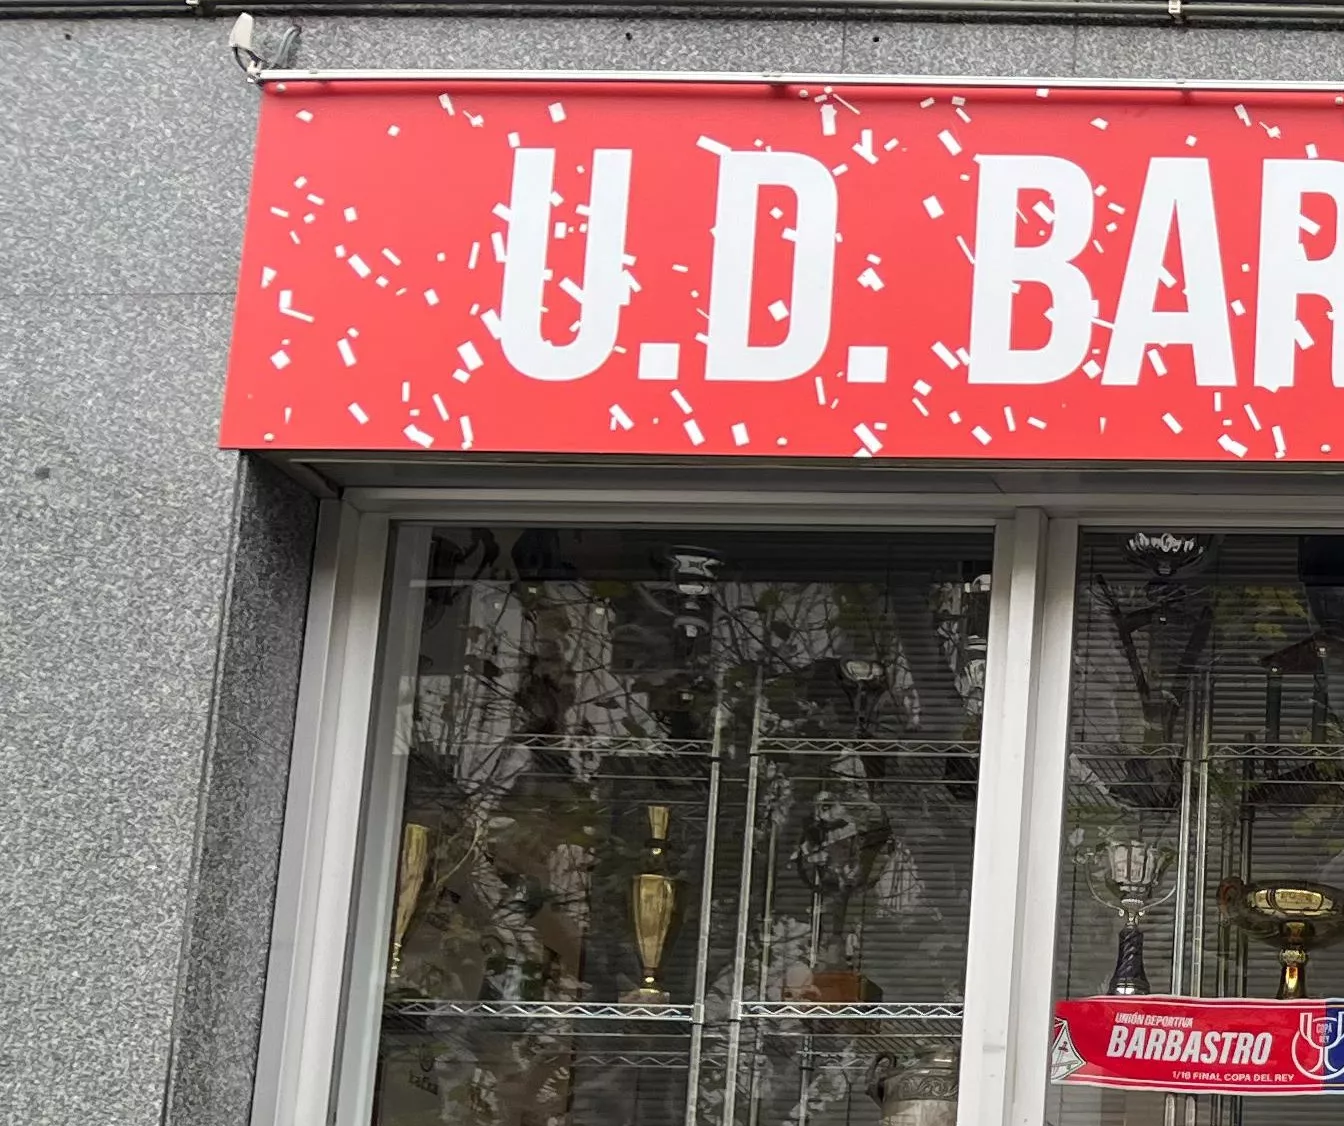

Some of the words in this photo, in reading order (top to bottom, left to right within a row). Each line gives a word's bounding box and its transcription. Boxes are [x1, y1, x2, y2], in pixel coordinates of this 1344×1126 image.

[498, 147, 888, 382] U.D.
[1146, 1013, 1194, 1029] DEPORTIVA
[1106, 1024, 1273, 1066] BARBASTRO
[1193, 1071, 1221, 1082] FINAL
[1223, 1072, 1252, 1083] COPA
[1252, 1072, 1274, 1083] DEL
[1274, 1072, 1295, 1083] REY
